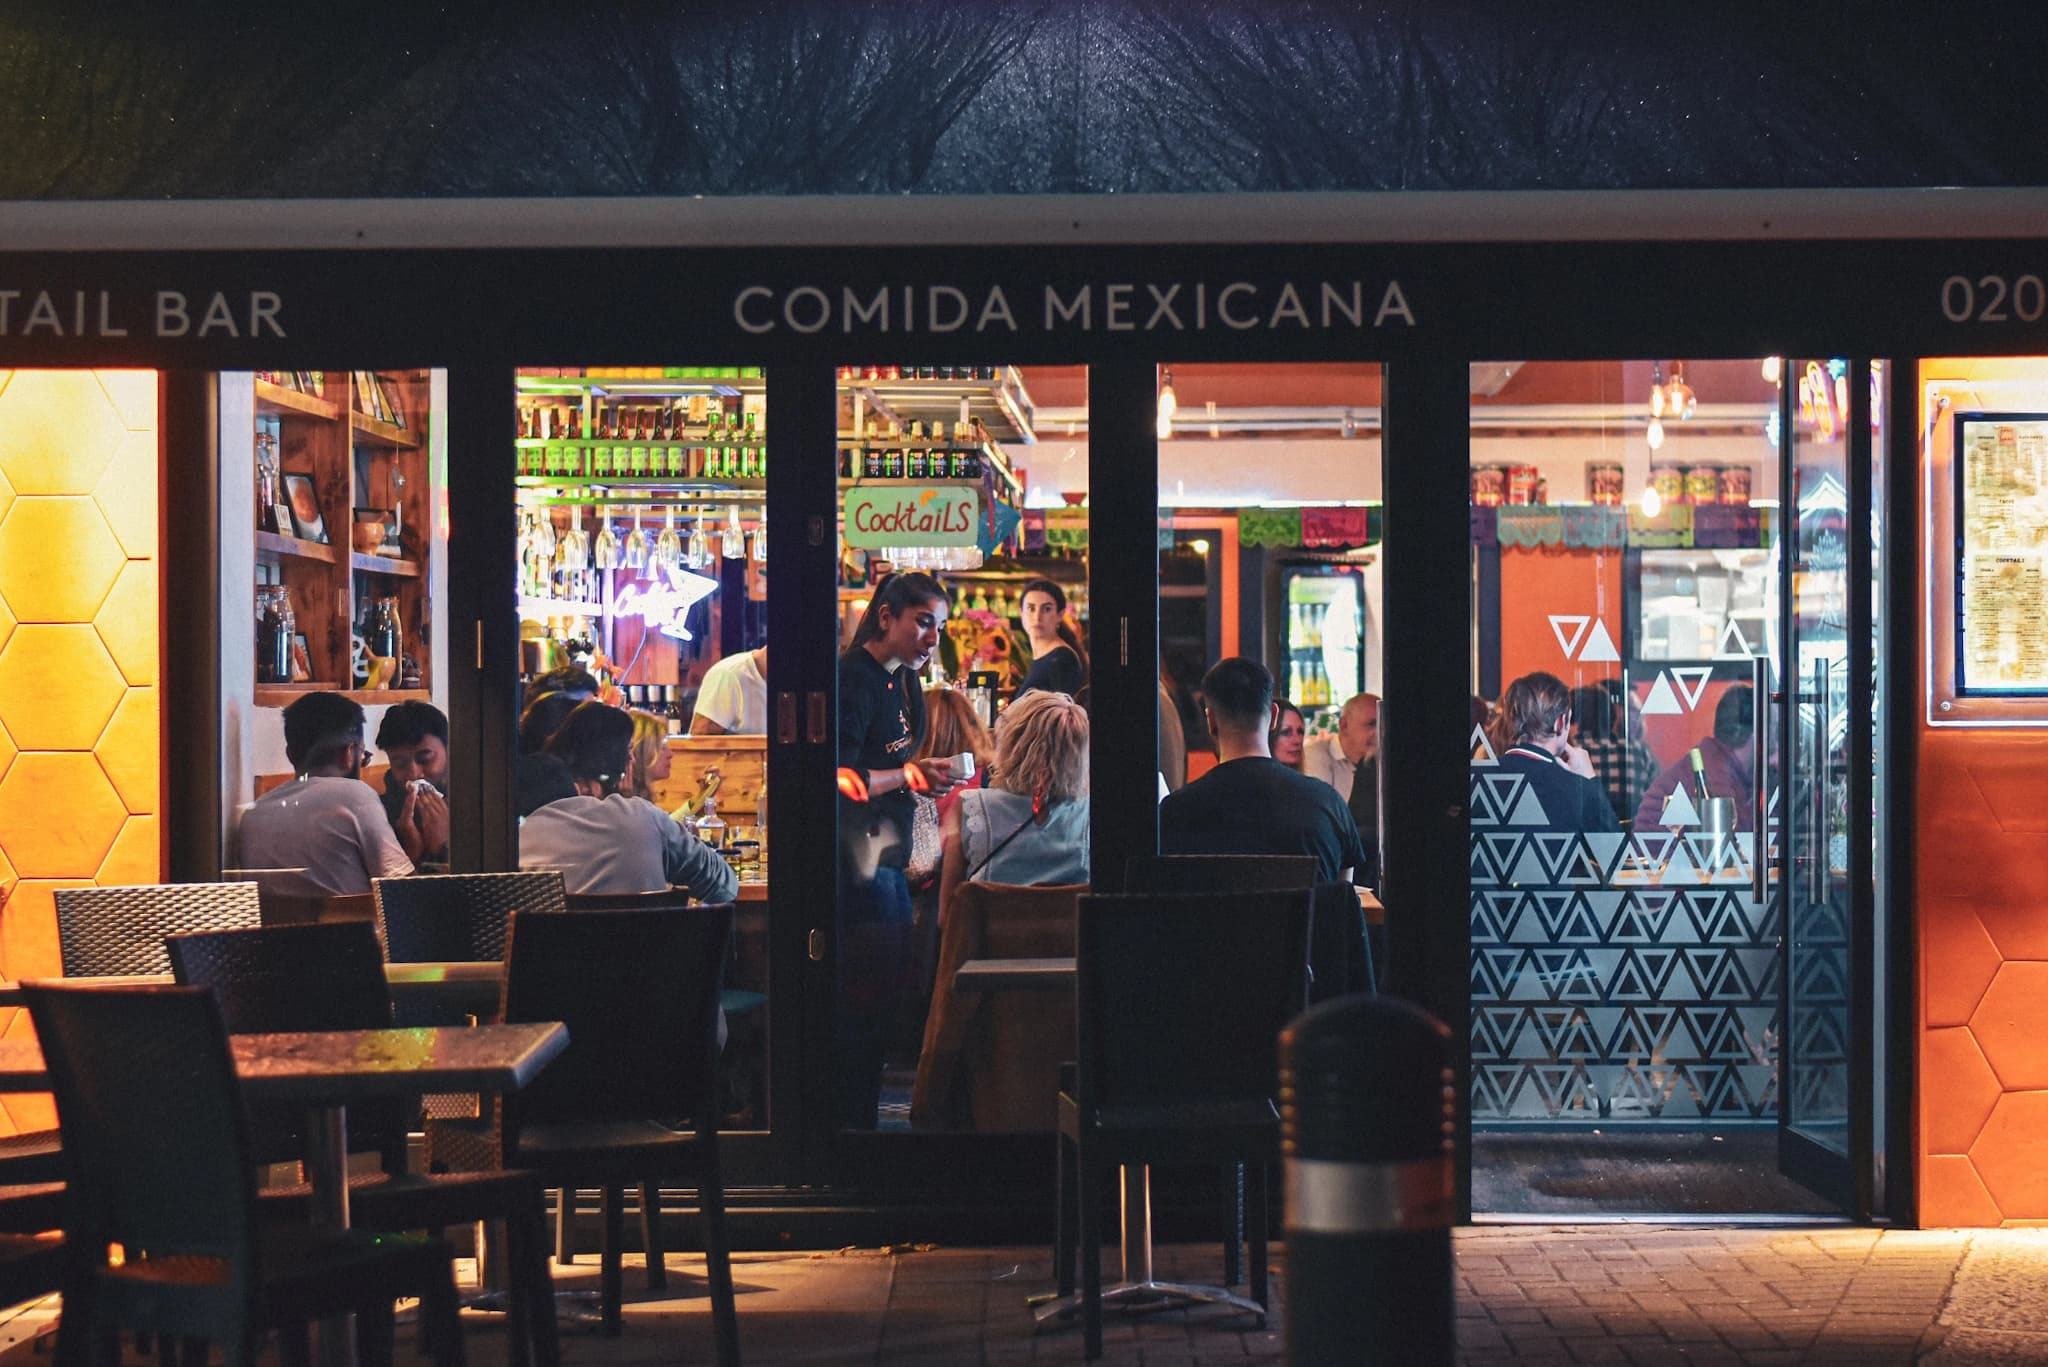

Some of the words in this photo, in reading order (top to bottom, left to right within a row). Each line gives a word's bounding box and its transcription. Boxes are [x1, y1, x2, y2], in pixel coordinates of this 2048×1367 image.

[156, 291, 286, 337] BAR
[734, 285, 1017, 333] COMIDA
[1044, 281, 1416, 330] MEXICANA
[1941, 275, 2046, 322] 020
